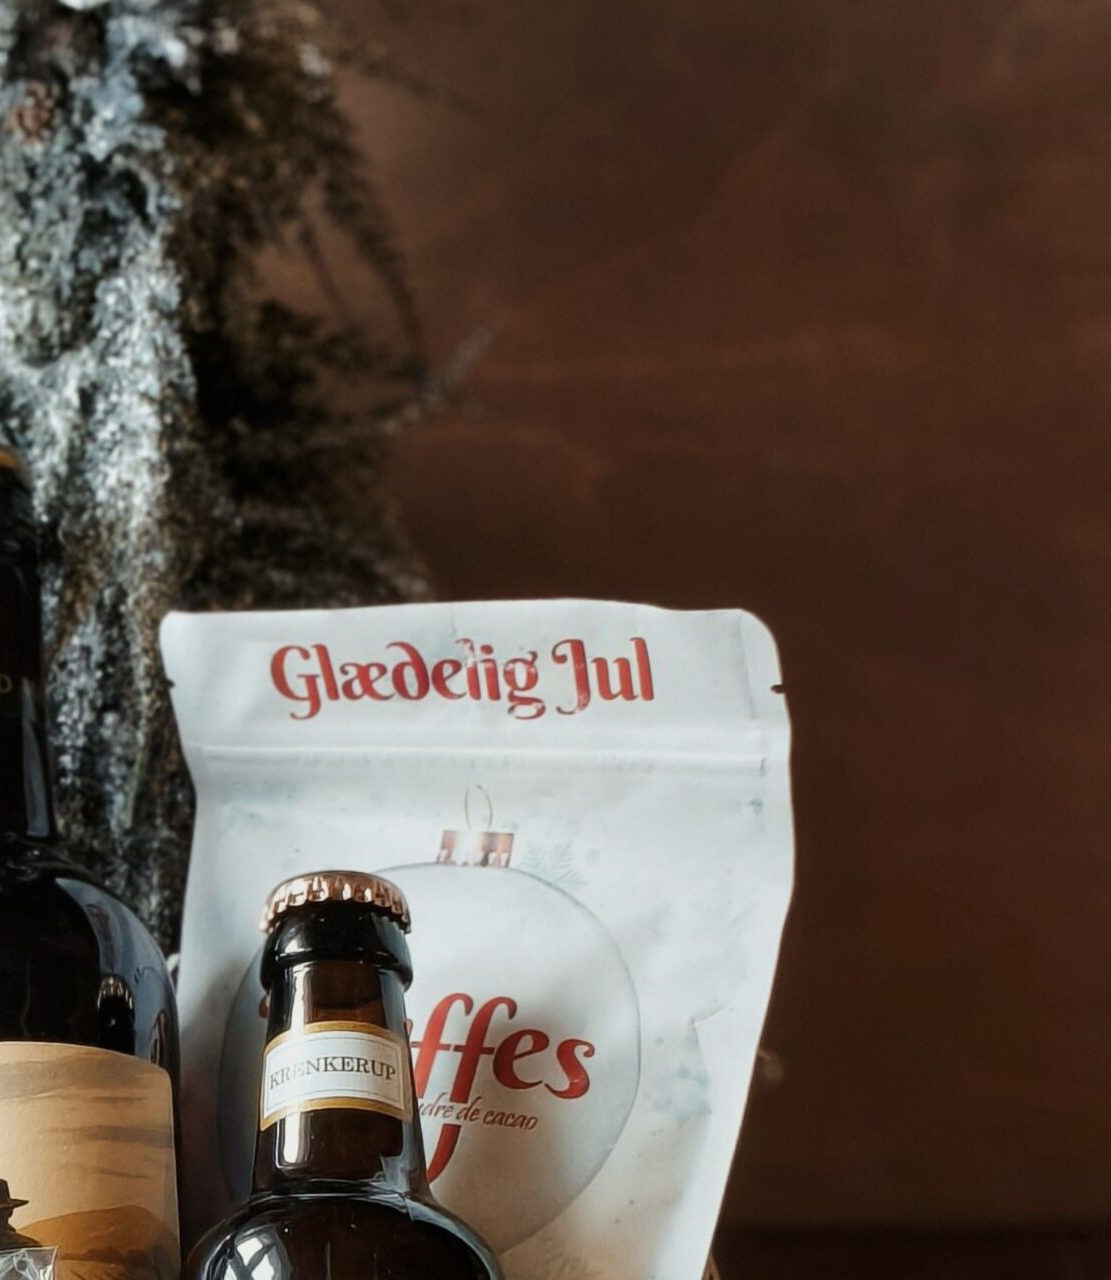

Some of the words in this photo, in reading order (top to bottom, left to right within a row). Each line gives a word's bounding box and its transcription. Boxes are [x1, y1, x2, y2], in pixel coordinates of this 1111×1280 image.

[550, 636, 655, 716] Jul
[270, 1056, 397, 1090] KRENKERUP
[456, 1095, 482, 1122] de
[483, 1109, 538, 1131] cacao
